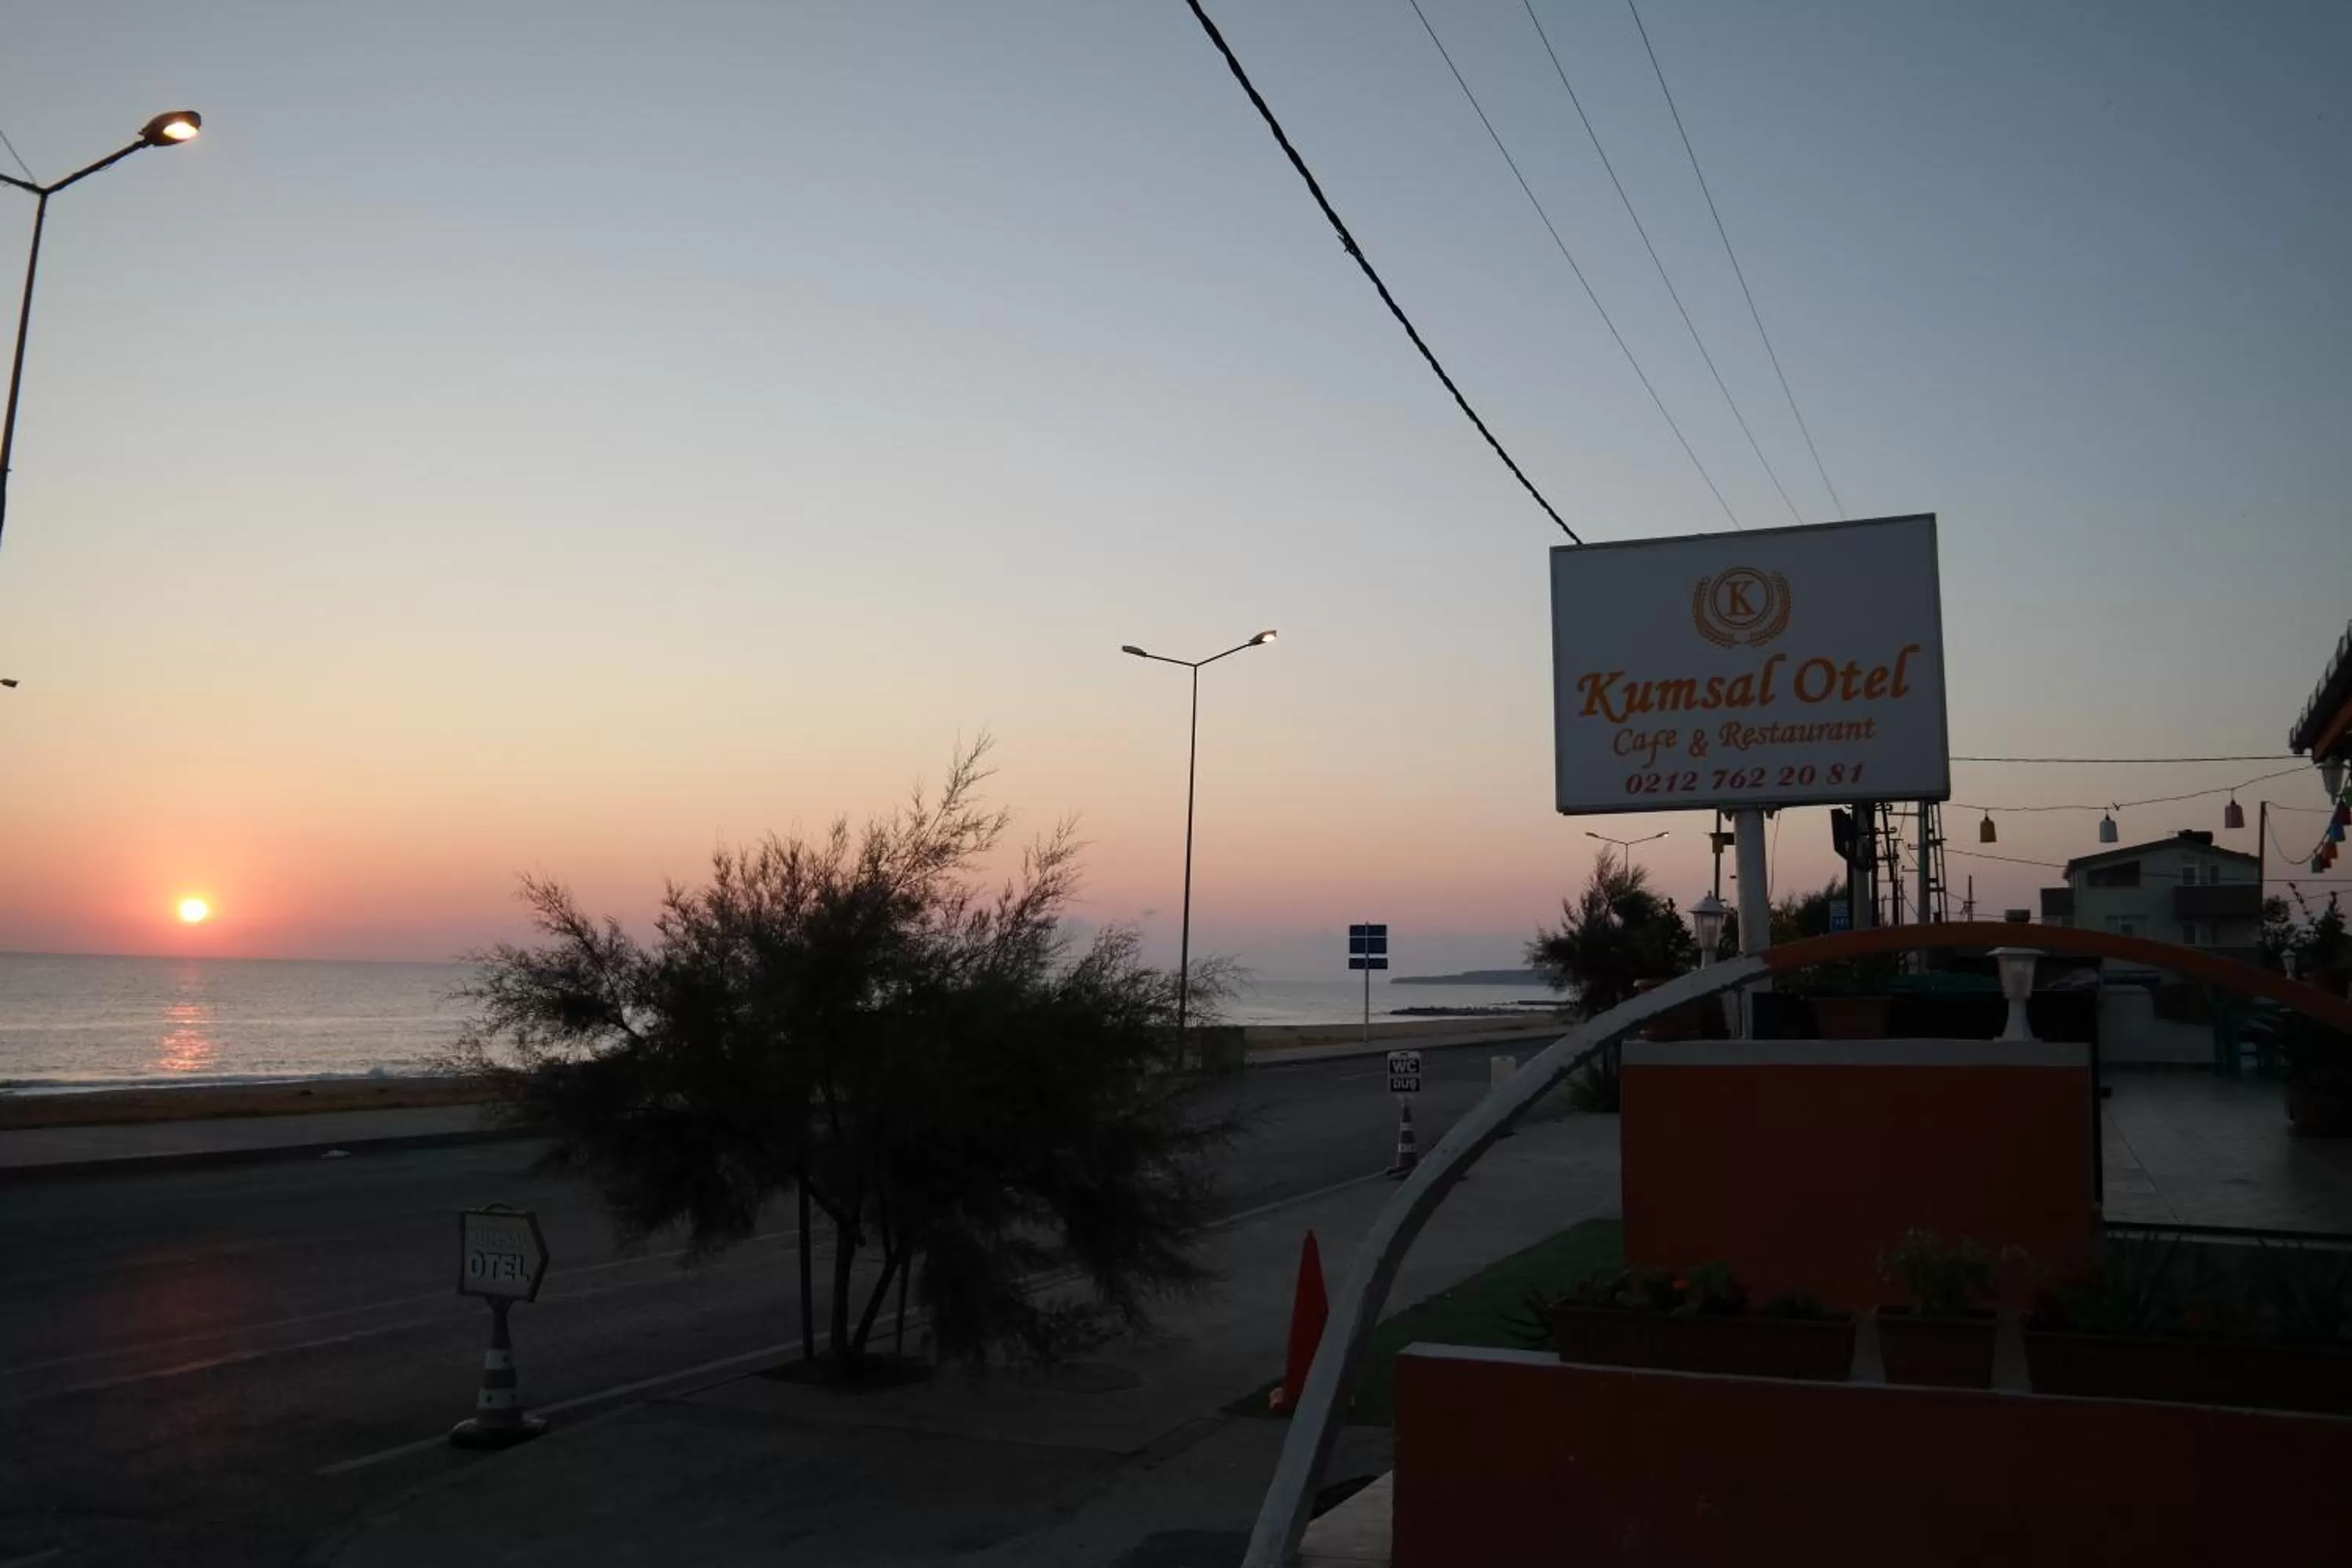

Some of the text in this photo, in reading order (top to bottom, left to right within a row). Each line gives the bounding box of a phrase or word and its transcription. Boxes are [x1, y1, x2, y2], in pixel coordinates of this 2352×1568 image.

[1726, 580, 1755, 615] K
[1577, 644, 1919, 724] Kumsal Otel
[1613, 717, 1876, 768] Cafe & Restaurant
[1625, 762, 1865, 795] 0212 762 20 81
[1392, 1060, 1417, 1073] WC
[469, 1250, 530, 1281] OTEL
